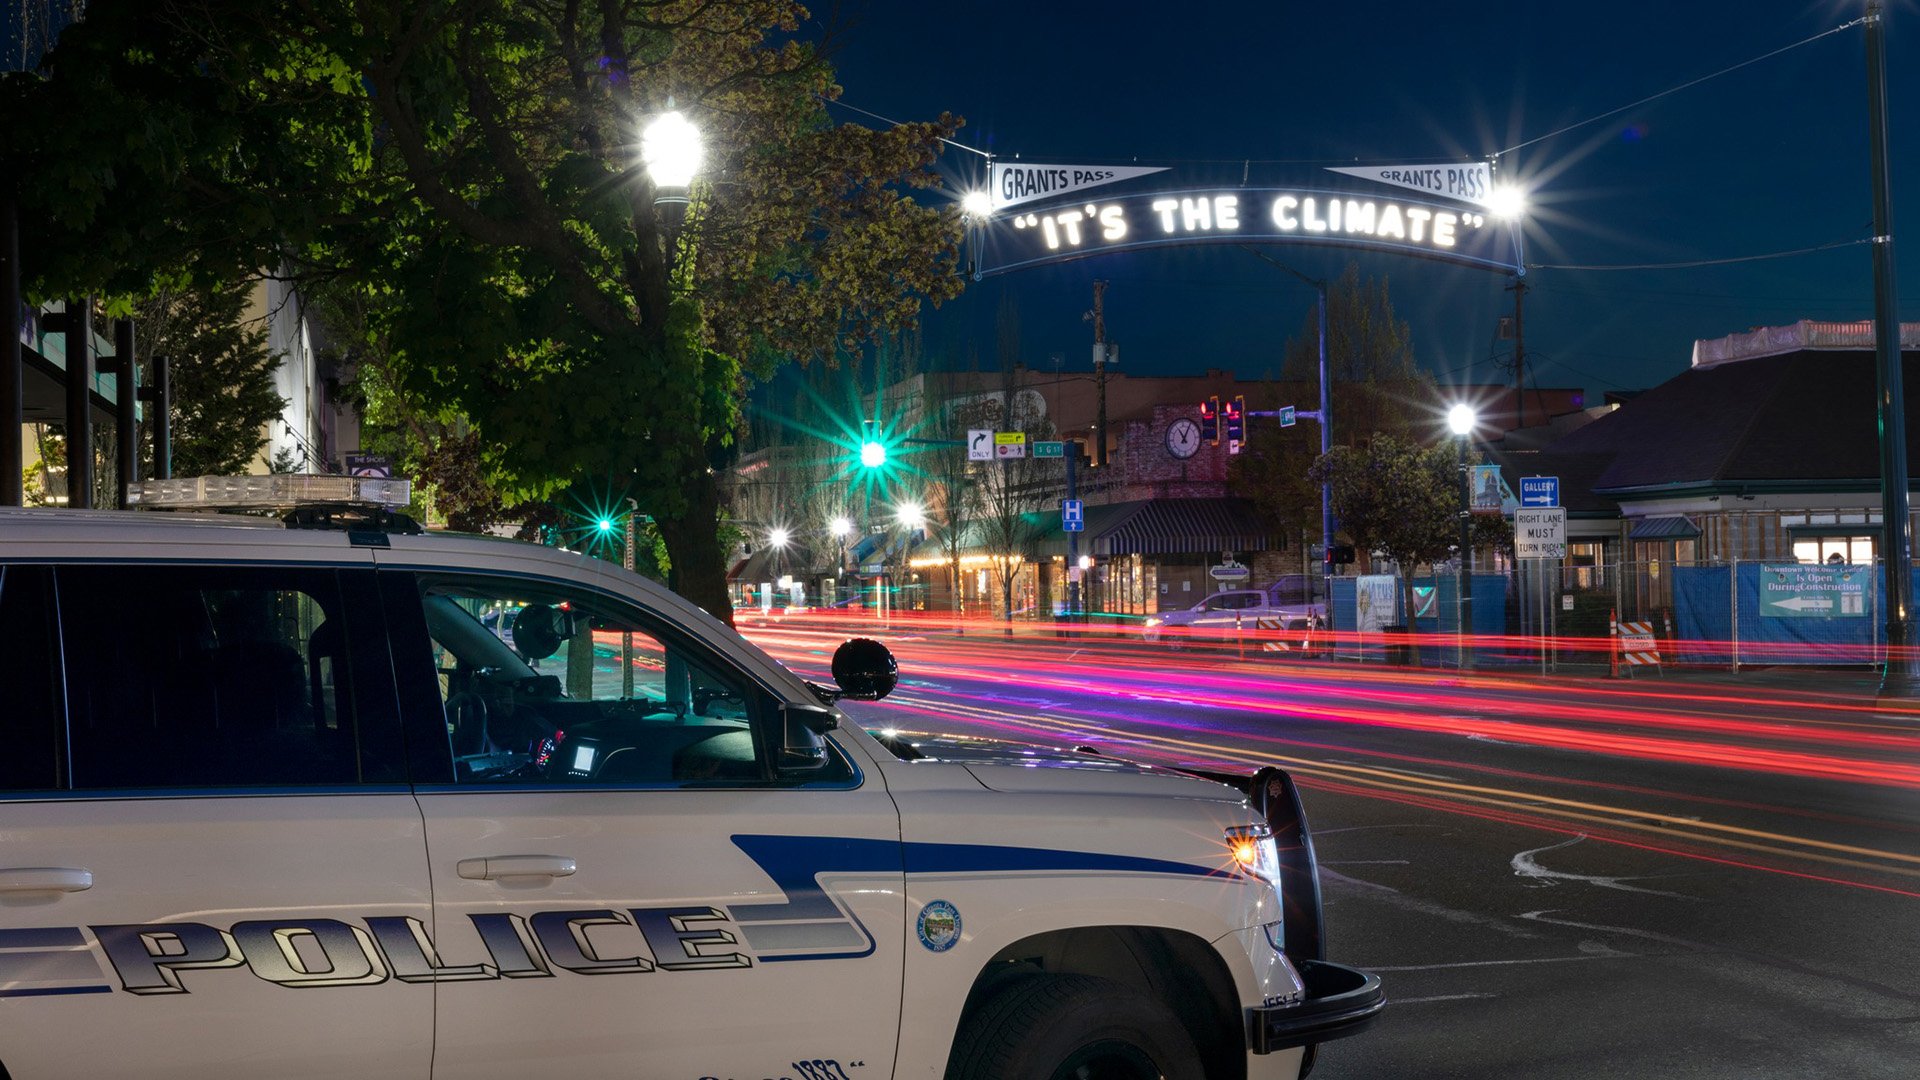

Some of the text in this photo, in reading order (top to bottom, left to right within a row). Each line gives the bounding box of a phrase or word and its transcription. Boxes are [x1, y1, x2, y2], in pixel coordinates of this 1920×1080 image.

[1002, 167, 1115, 201] GRANTS PASS
[1380, 168, 1486, 200] GRANTS PASS
[1152, 195, 1239, 233] THE
[1046, 445, 1052, 454] G
[1524, 482, 1555, 492] GALLERY
[1065, 501, 1080, 520] H
[1519, 514, 1562, 523] RIGHT LANE
[1528, 528, 1554, 538] MUST
[1519, 544, 1538, 552] TURN
[1796, 574, 1833, 584] Is Open
[87, 906, 753, 996] POLICE
